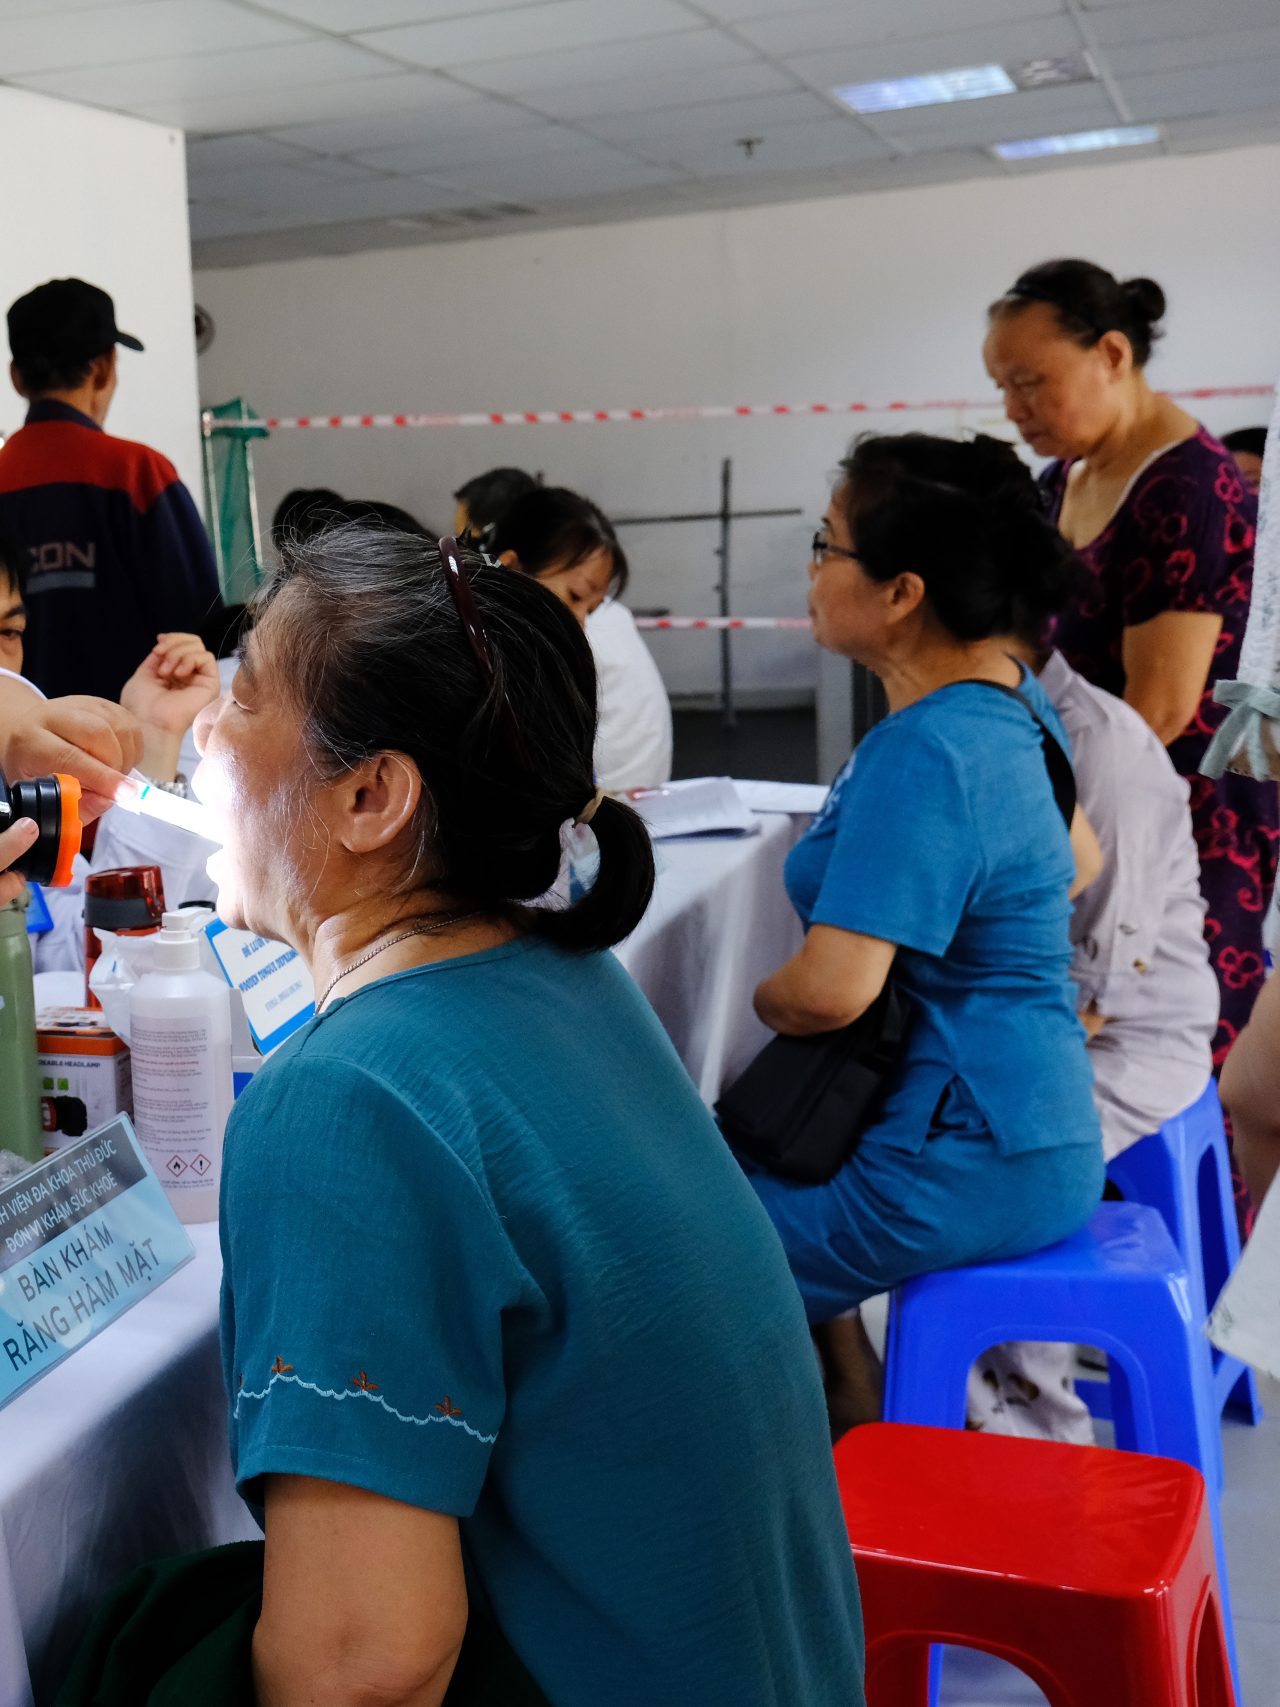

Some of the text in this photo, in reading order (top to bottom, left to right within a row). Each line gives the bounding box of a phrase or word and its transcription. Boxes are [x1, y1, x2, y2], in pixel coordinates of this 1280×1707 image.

[7, 1191, 33, 1217] VIỆN
[31, 1182, 50, 1203] ĐA
[47, 1165, 77, 1192] KHOA
[74, 1149, 96, 1175] THỦ
[94, 1139, 117, 1163] ĐỨC
[5, 1228, 32, 1253] ĐƠN
[29, 1219, 46, 1238] VỊ
[41, 1202, 73, 1230] KHÁM
[70, 1188, 92, 1212] SỨC
[17, 1256, 62, 1302] BÀN
[59, 1221, 114, 1273] KHÁM
[2, 1237, 159, 1372] RĂNG HÀM MẶT
